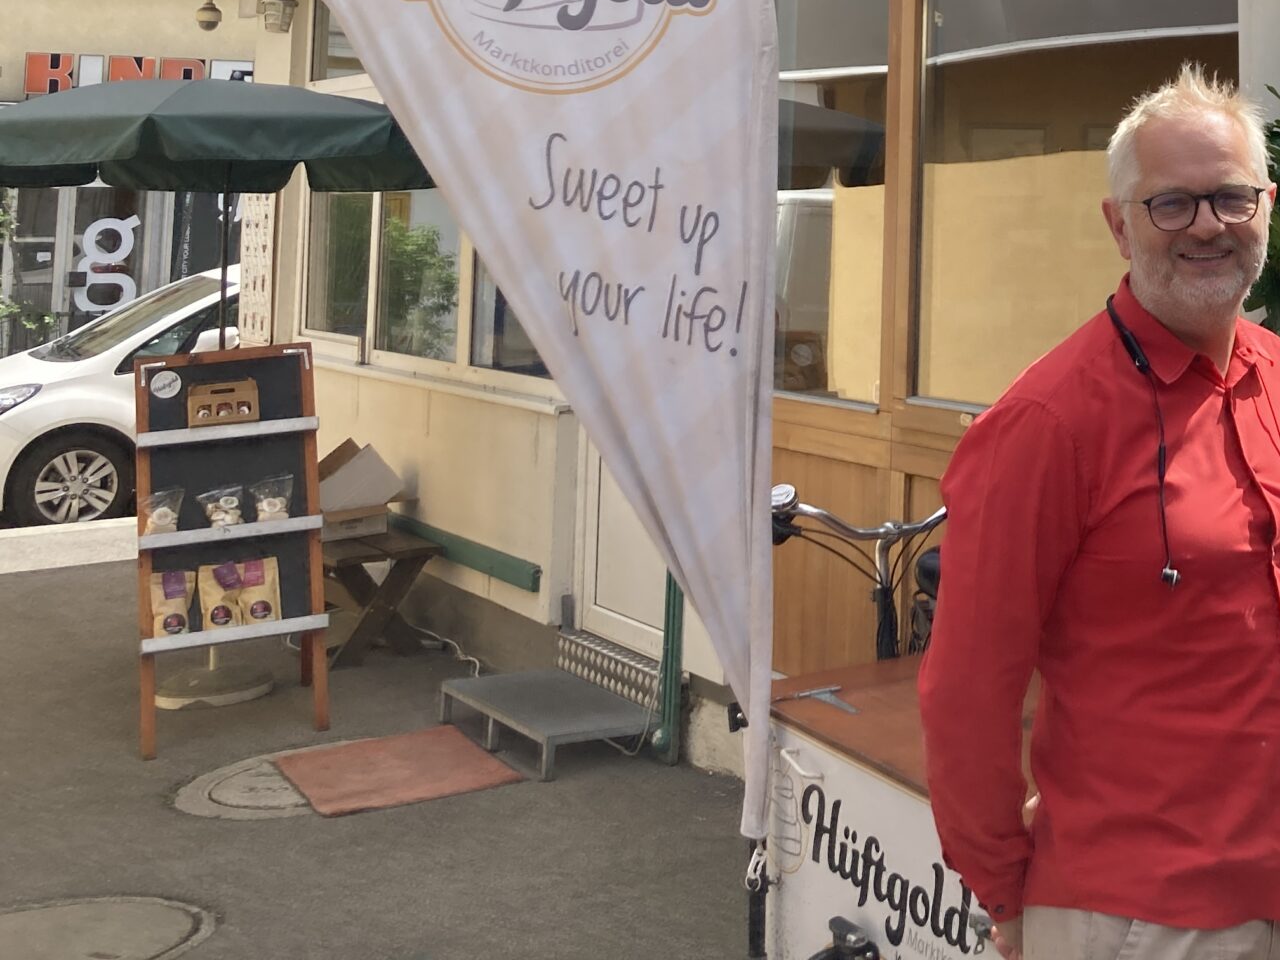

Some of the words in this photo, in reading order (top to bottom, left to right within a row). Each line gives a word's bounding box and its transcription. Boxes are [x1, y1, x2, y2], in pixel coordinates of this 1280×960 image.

[472, 28, 630, 77] Marktkonditorei
[528, 132, 665, 234] Sweet
[679, 202, 720, 276] up
[558, 268, 646, 337] your
[661, 272, 749, 358] life!
[801, 783, 971, 955] Hüftgold
